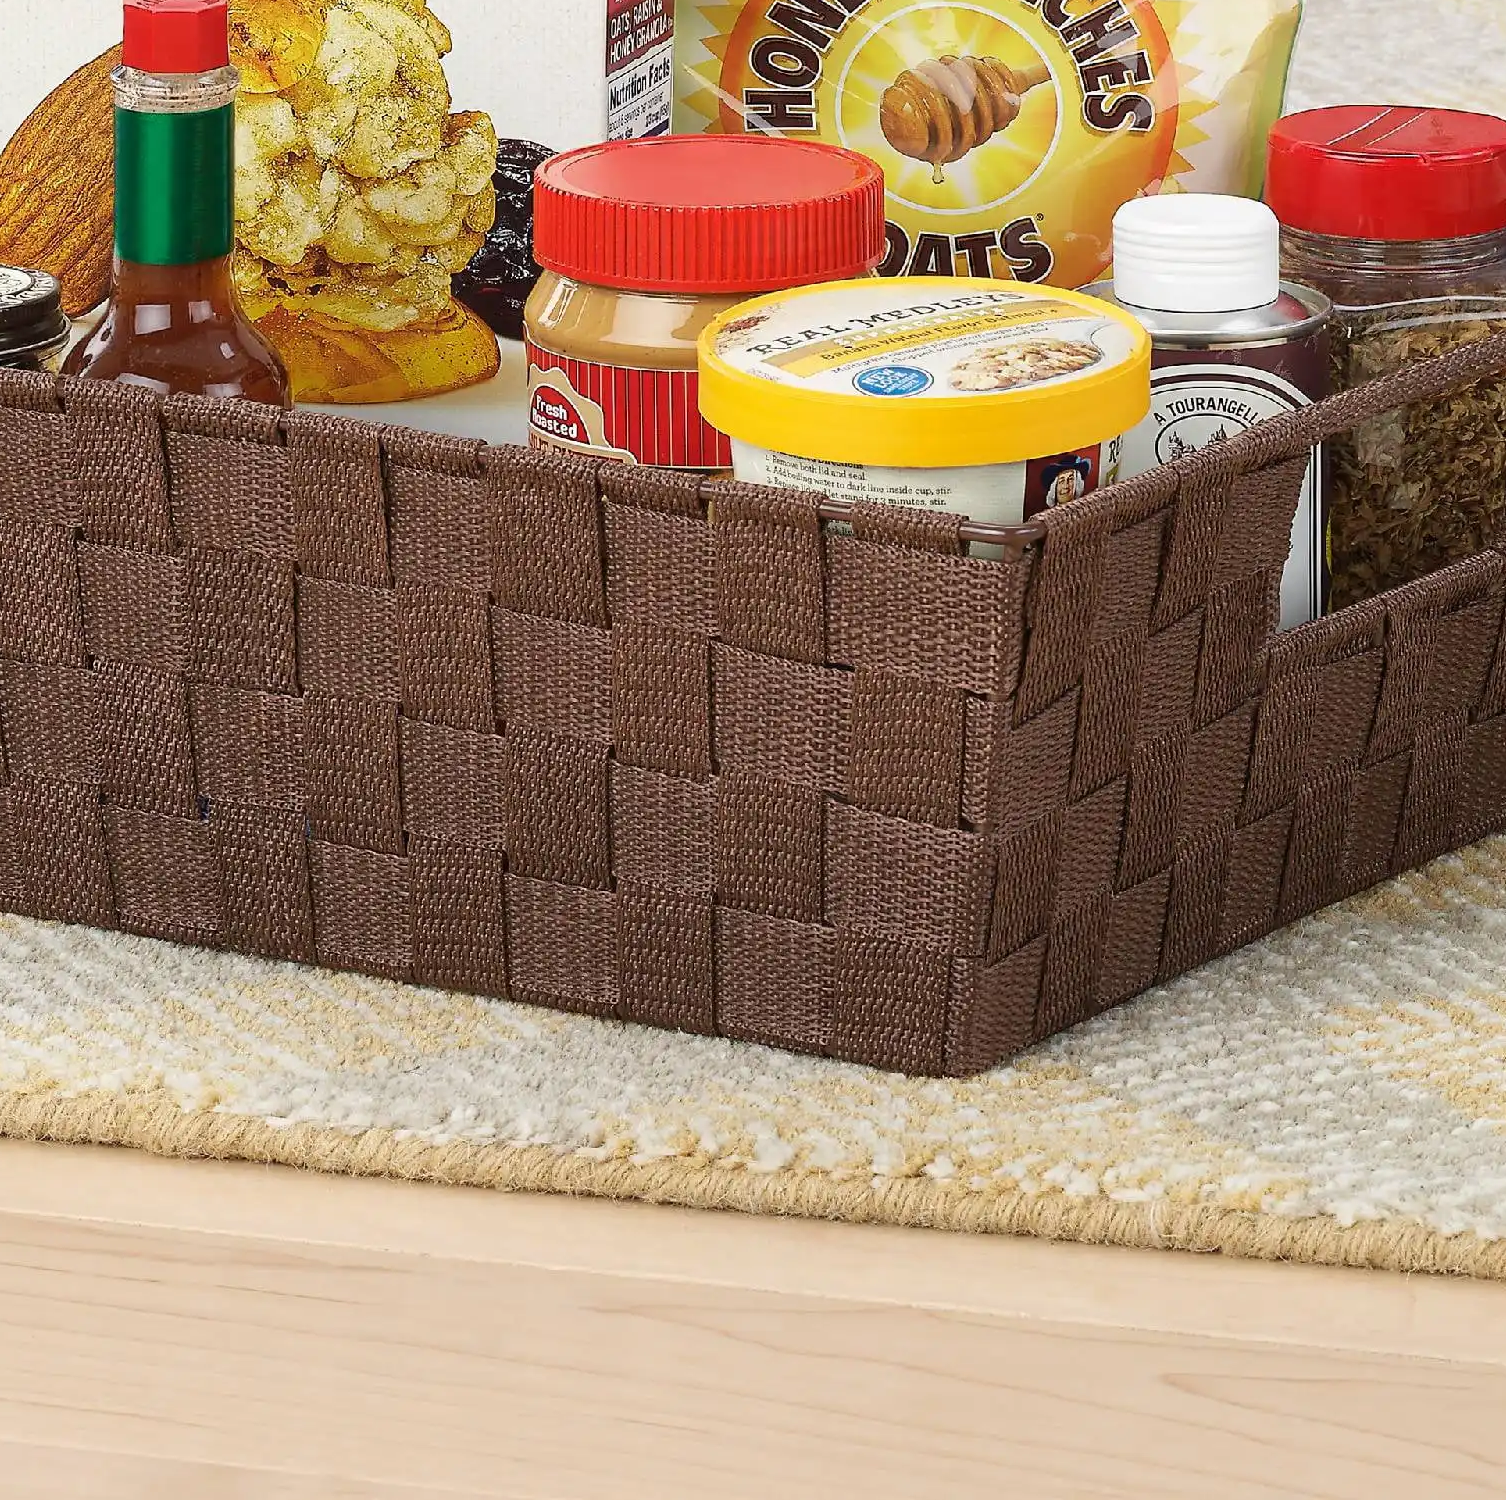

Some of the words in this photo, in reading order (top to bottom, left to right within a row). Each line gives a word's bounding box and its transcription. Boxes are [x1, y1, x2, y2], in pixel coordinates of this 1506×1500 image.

[610, 11, 633, 39] OATS,
[609, 32, 637, 65] HONEY
[636, 16, 668, 48] GRANOLA
[608, 71, 648, 112] Nutrition
[648, 56, 671, 88] Facts
[747, 324, 849, 355] REAL
[849, 292, 1026, 330] MEDLEYS
[821, 339, 882, 361] Banana
[881, 329, 932, 349] Walnut
[933, 319, 982, 337] Flavor
[985, 308, 1046, 326] Oatmeal
[532, 406, 578, 439] Roasted
[536, 394, 568, 422] Fresh
[1165, 397, 1264, 427] TOURANGELL
[772, 454, 799, 470] Remove
[799, 461, 818, 474] both
[818, 465, 830, 476] lid
[830, 469, 847, 478] and
[813, 477, 835, 487] water
[836, 481, 845, 489] to
[846, 480, 867, 492] dark
[886, 485, 913, 496] inside
[914, 487, 935, 497] cup,
[887, 497, 927, 507] minutes,
[929, 498, 947, 506] stir.
